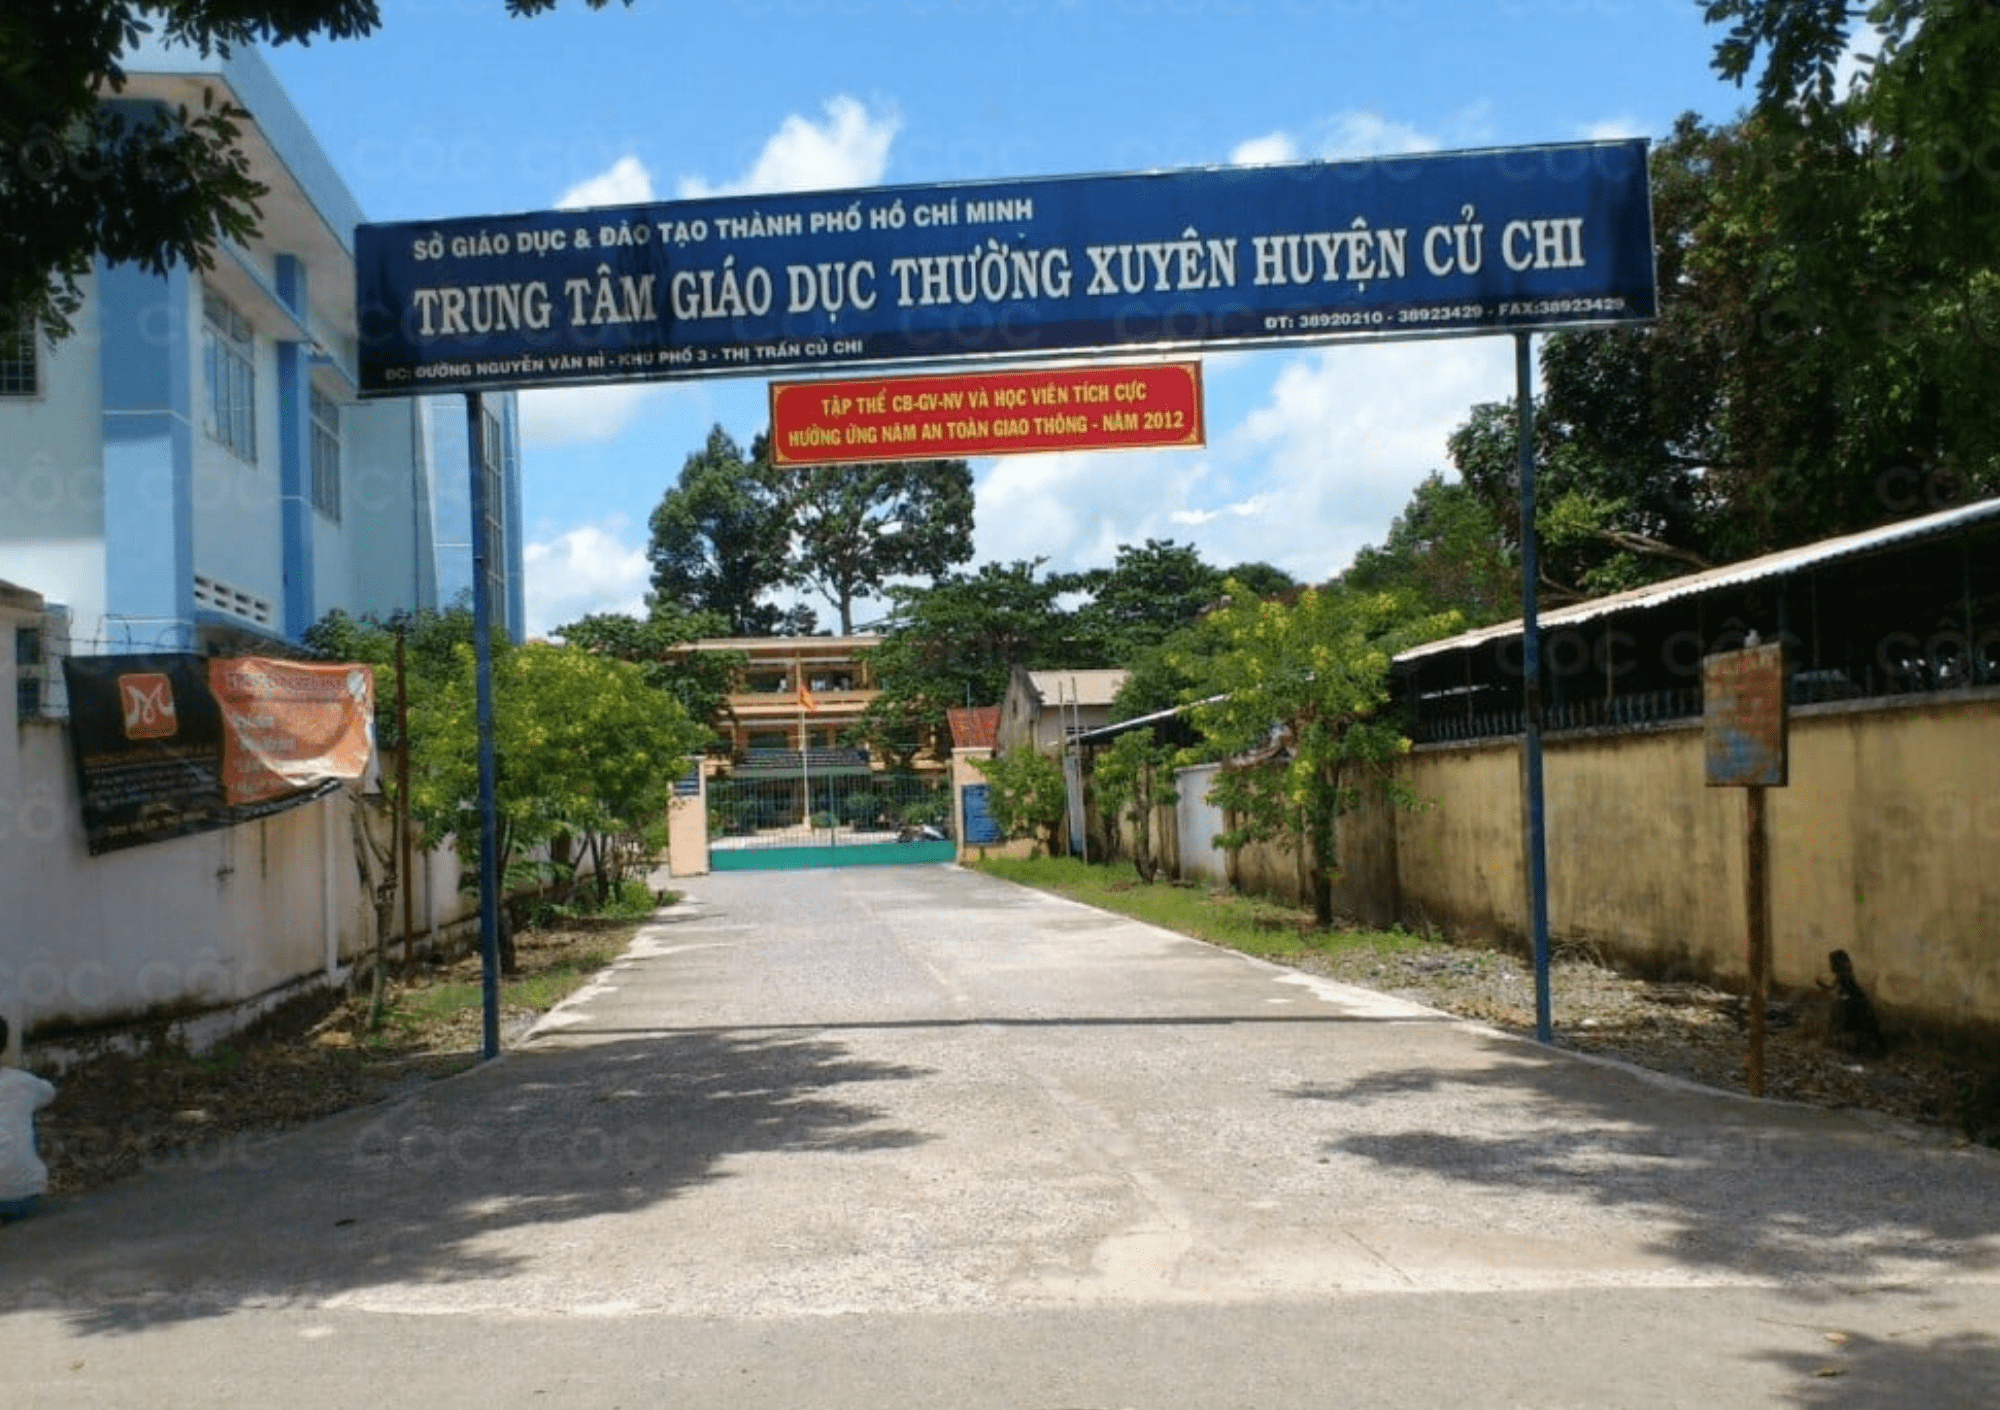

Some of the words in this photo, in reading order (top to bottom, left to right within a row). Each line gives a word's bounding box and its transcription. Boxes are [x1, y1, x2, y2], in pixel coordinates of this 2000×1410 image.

[413, 231, 445, 260] SỞ
[452, 229, 511, 259] GIÁO
[517, 229, 567, 258] DỤC
[574, 228, 593, 249] &
[600, 219, 650, 246] ĐÀO
[657, 219, 708, 248] TẠO
[714, 210, 802, 240] THÀNH
[810, 201, 862, 234] PHỐ
[913, 197, 958, 227] CHÍ
[966, 198, 1033, 224] MINH
[414, 282, 552, 336] TRUNG
[565, 263, 657, 327] TÂM
[671, 253, 772, 321] GIÁO
[787, 261, 876, 324] DỤC
[891, 237, 1072, 307] THƯỜNG
[1086, 225, 1238, 295] XUYÊN
[1252, 216, 1407, 293] HUYỆN
[1424, 203, 1483, 276] CỦ
[1502, 218, 1586, 271] CHI
[1299, 311, 1383, 329] 38920210
[1398, 304, 1483, 322] 38923429
[476, 354, 544, 376] NGUYỄN
[658, 346, 692, 363] PHỐ
[697, 349, 707, 361] 3
[721, 348, 750, 363] THỊ
[755, 340, 800, 359] TRẤN
[833, 340, 863, 354] CHI
[856, 386, 887, 414] THỂ
[892, 391, 964, 413] CB-GV-NV
[968, 386, 989, 408] VÀ
[994, 388, 1026, 410] HỌC
[1031, 382, 1068, 405] VIÊN
[1074, 381, 1109, 403] TÍCH
[1114, 379, 1147, 404] CỰC
[882, 422, 917, 443] NĂM
[921, 422, 943, 440] AN
[946, 416, 989, 439] TOÀN
[993, 418, 1029, 437] GIAO
[1034, 412, 1088, 434] THÔNG
[1103, 410, 1139, 431] NĂM
[1144, 410, 1184, 430] 2012
